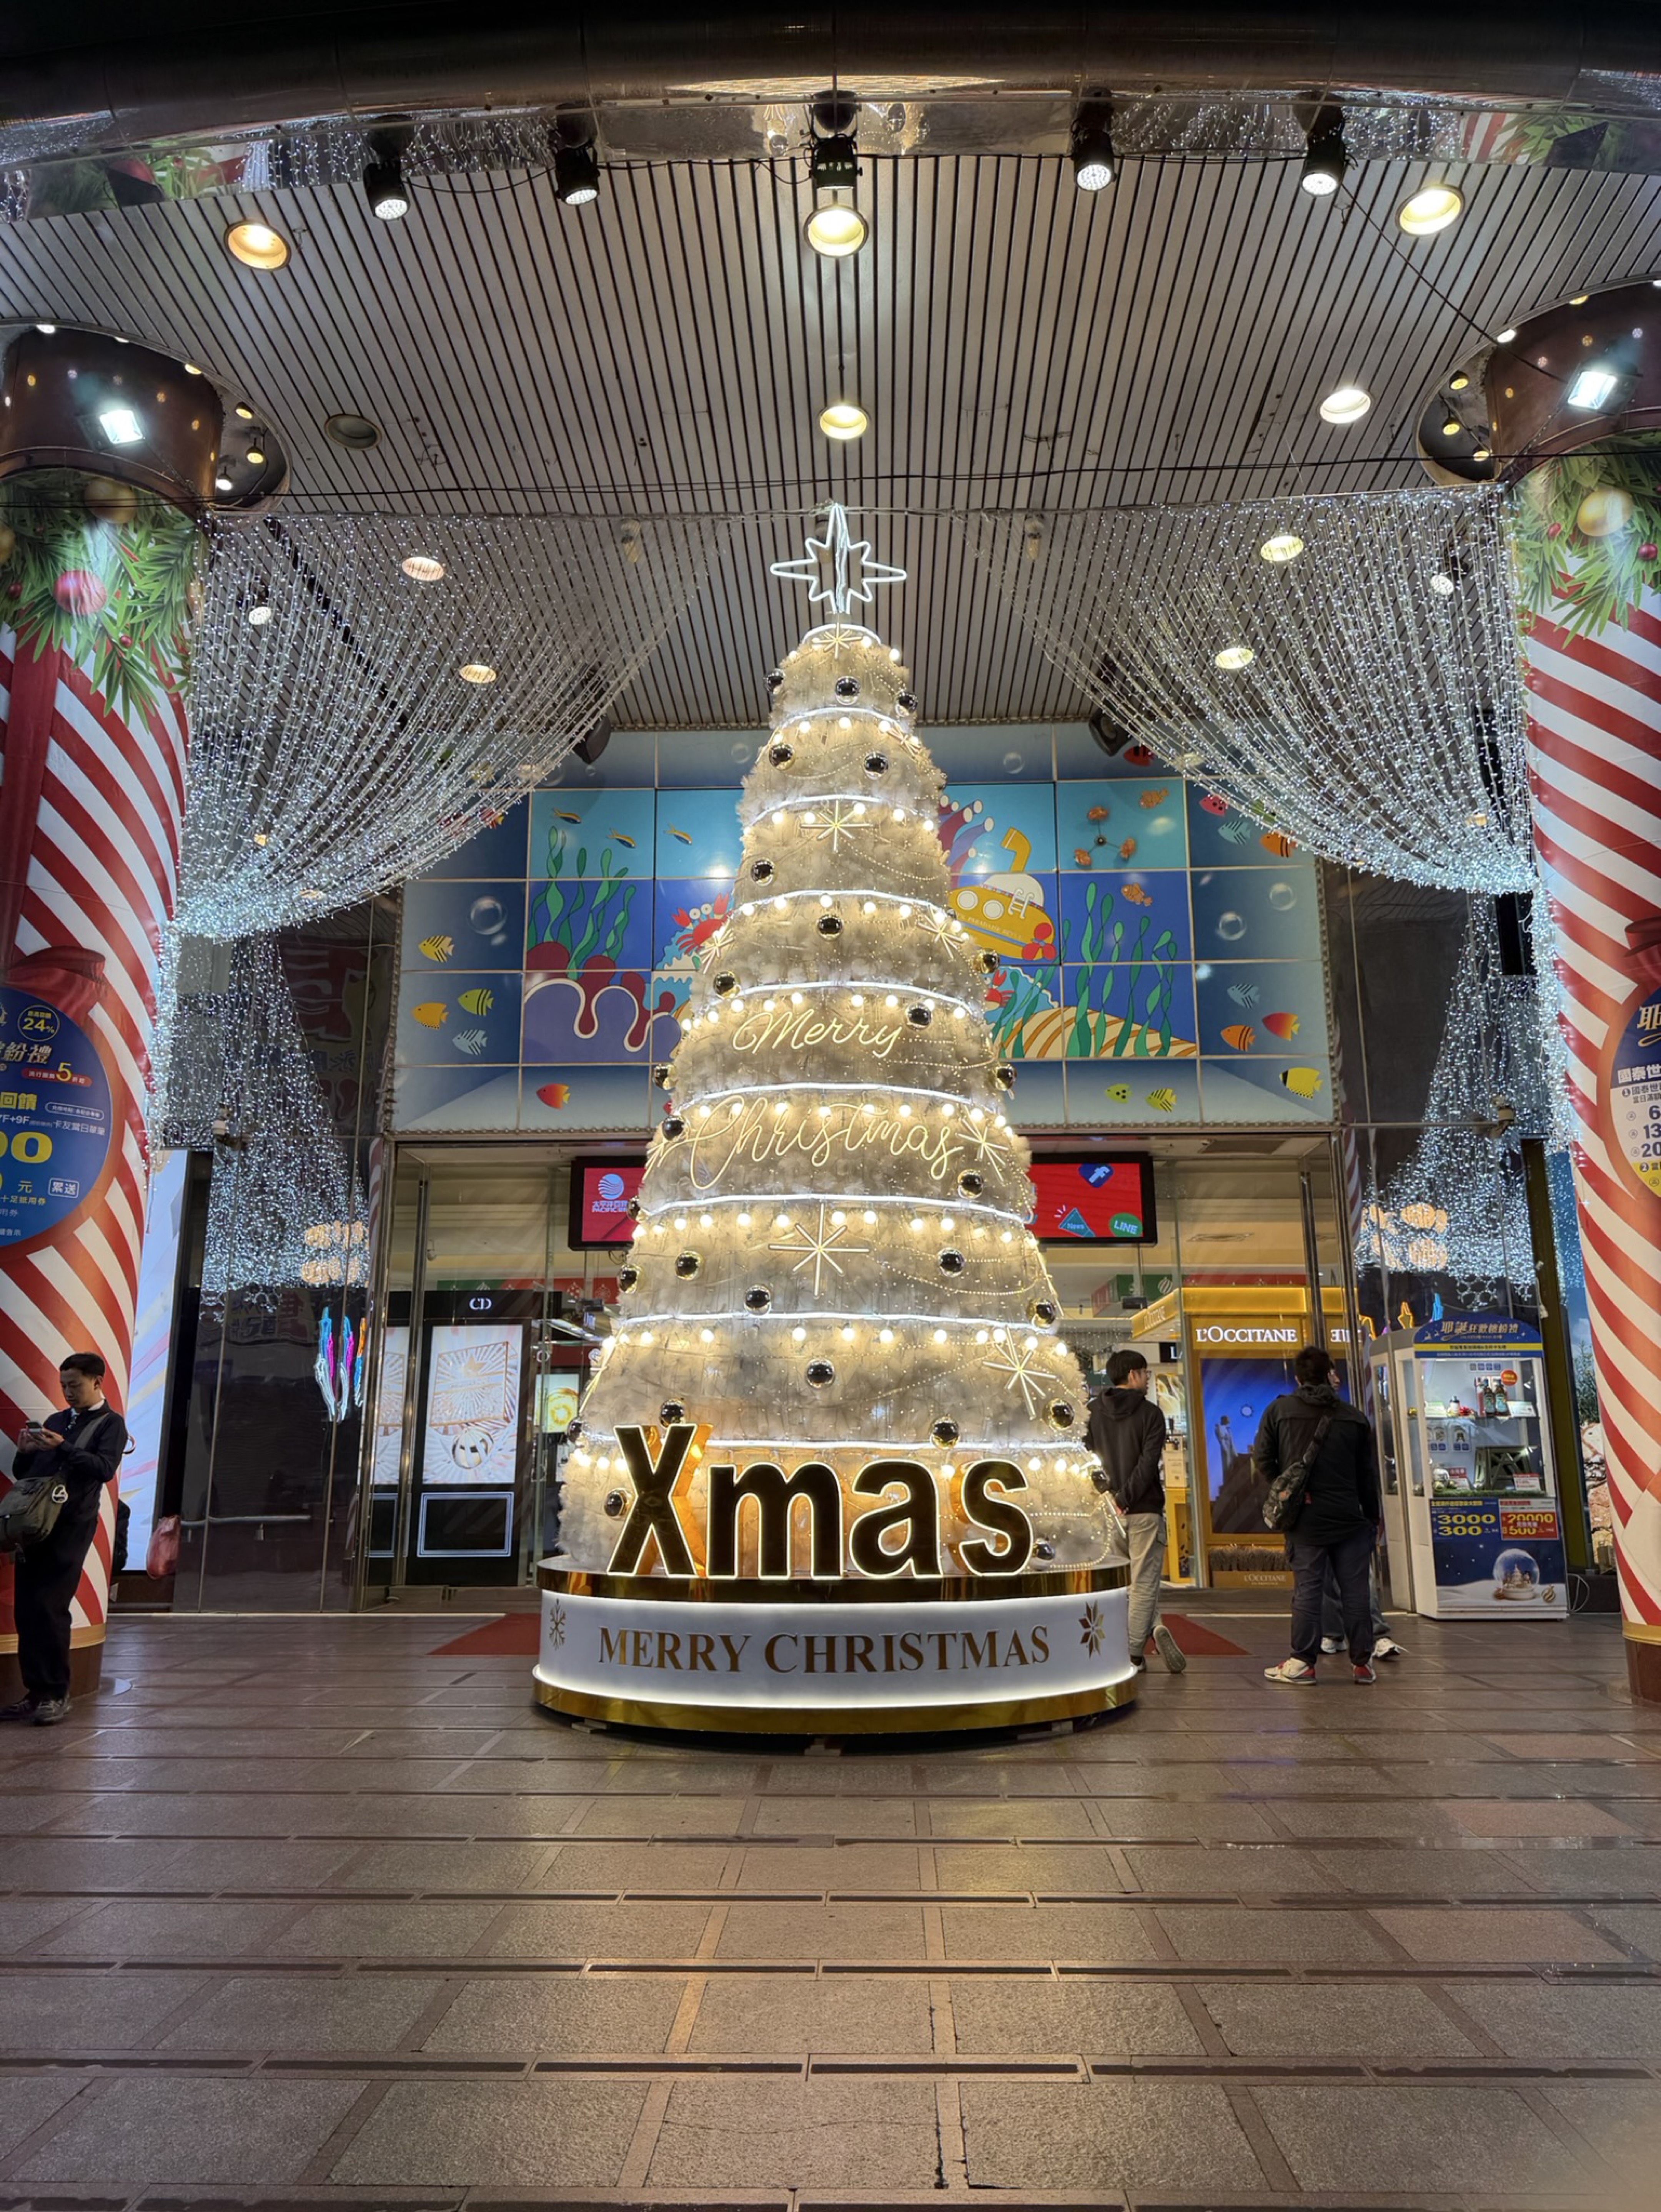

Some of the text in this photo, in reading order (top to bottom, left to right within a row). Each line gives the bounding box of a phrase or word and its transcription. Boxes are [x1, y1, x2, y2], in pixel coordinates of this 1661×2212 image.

[22, 1018, 55, 1033] 24%
[733, 1008, 903, 1058] Merry
[0, 1041, 52, 1064] 紛禮
[657, 1096, 964, 1189] Christmas
[52, 1181, 77, 1195] 累送
[1113, 1219, 1138, 1234] LINE
[1196, 1326, 1298, 1342] L'OCCITANE
[607, 1424, 1034, 1579] Xmas
[1437, 1514, 1495, 1524] 3000
[1438, 1525, 1482, 1536] 300
[598, 1625, 1050, 1674] MERRY CHRISTMAS
